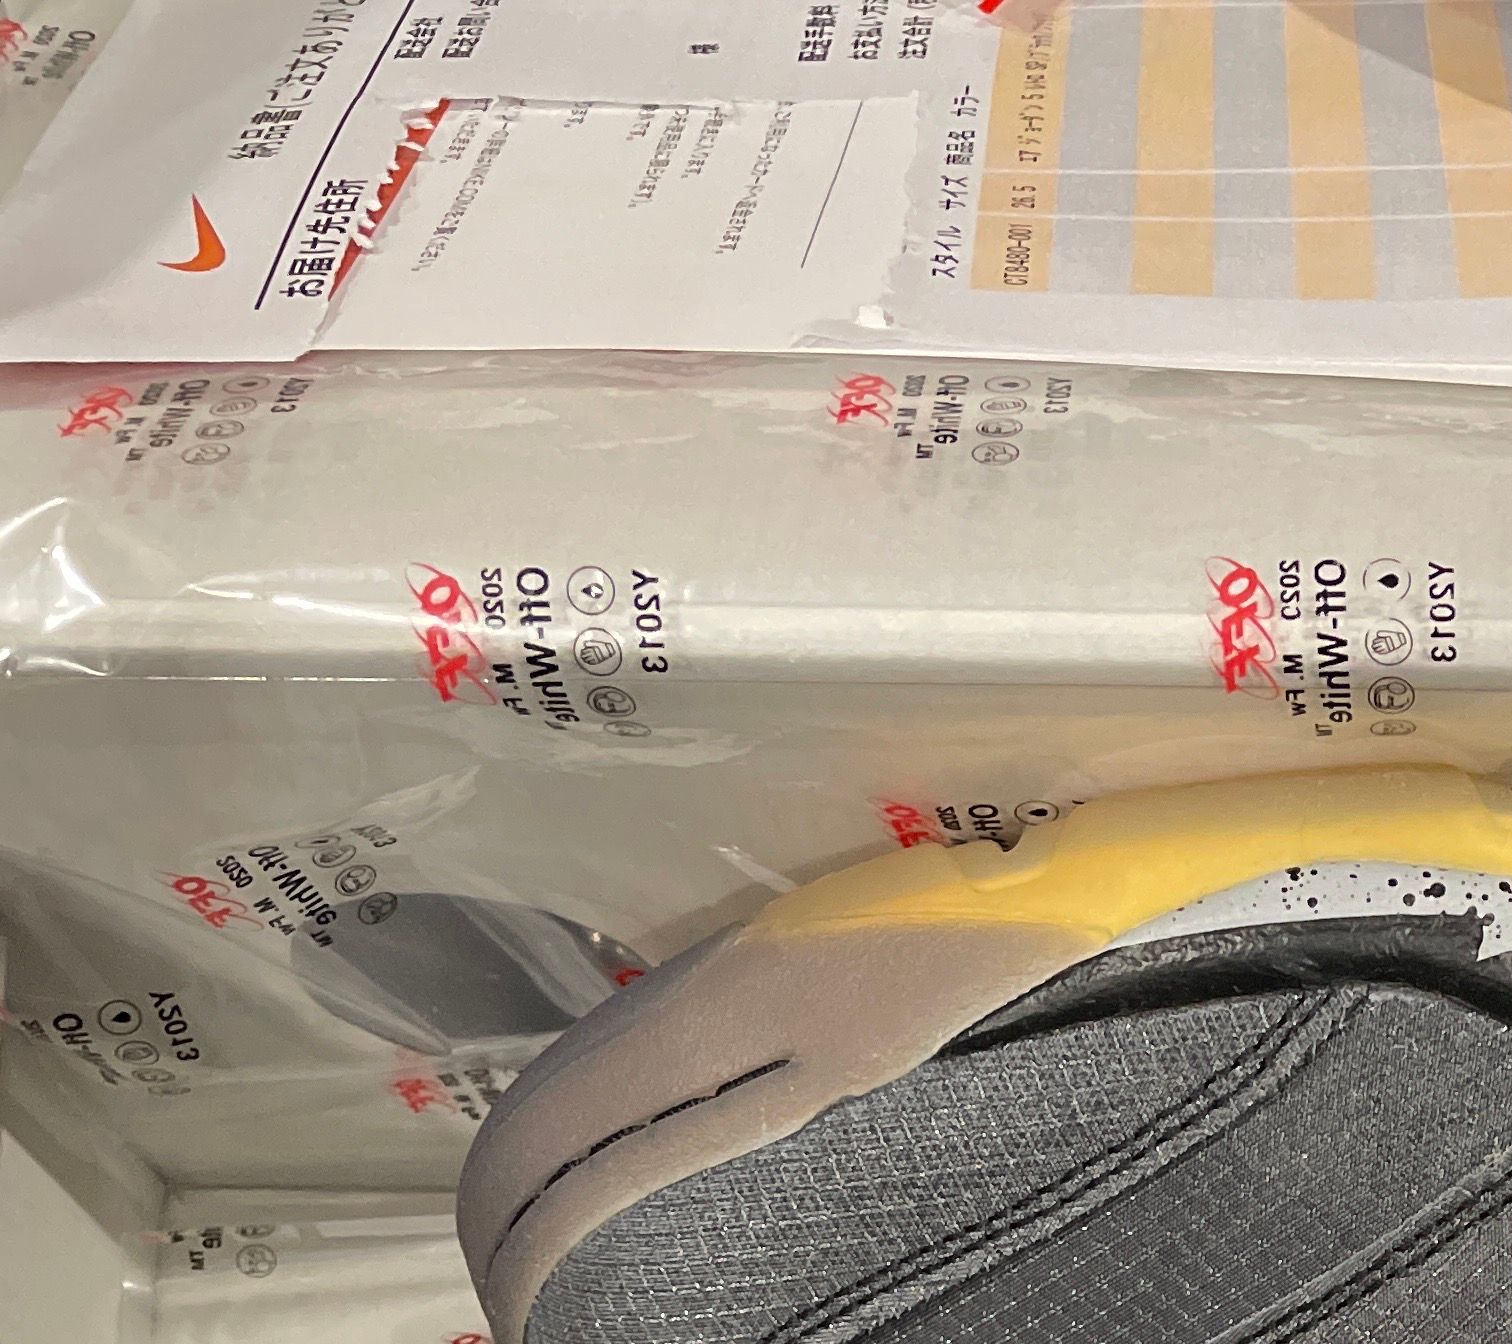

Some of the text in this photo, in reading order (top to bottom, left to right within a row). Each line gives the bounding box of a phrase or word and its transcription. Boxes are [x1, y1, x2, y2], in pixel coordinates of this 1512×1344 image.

[930, 85, 981, 279] スタイル サイズ 商品名 カラー
[1010, 185, 1037, 209] 26.5
[279, 179, 368, 298] お届け先住所
[1003, 223, 1034, 286] CT8480-001
